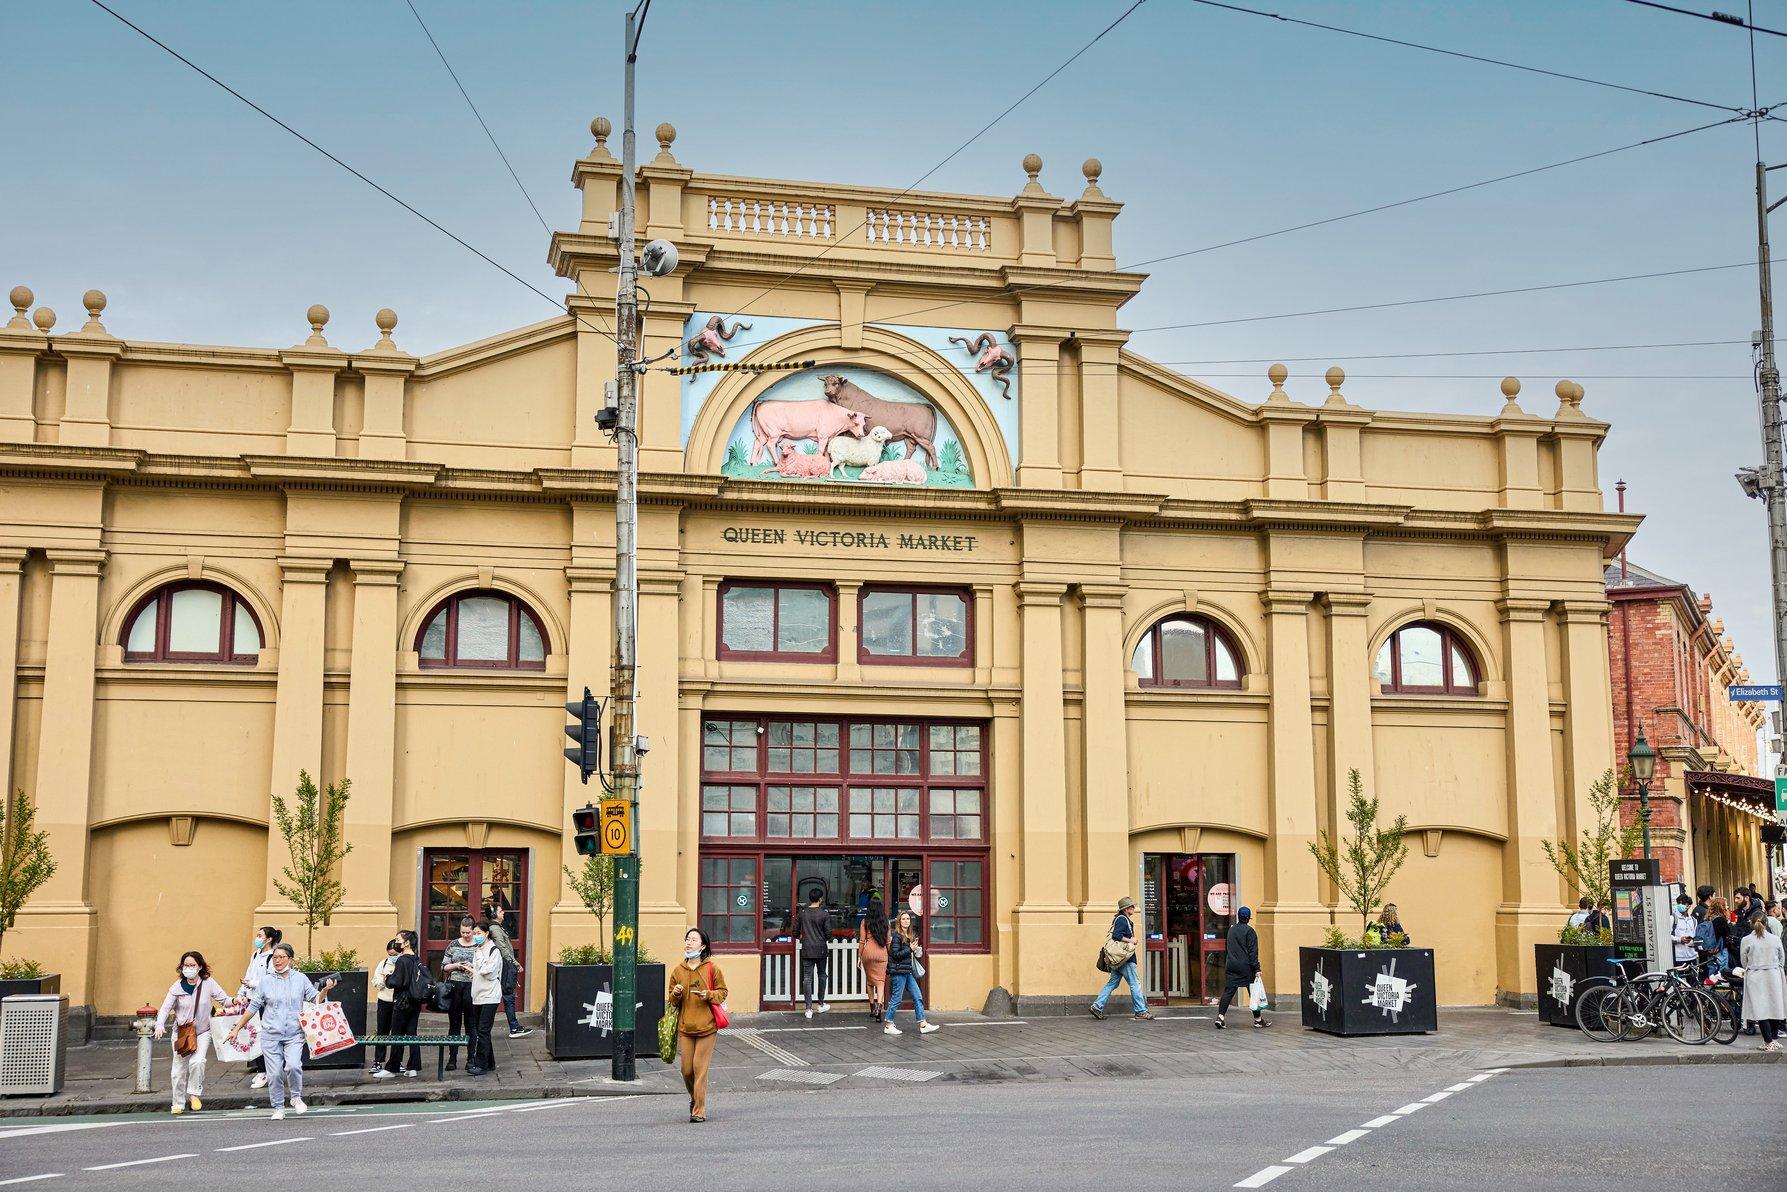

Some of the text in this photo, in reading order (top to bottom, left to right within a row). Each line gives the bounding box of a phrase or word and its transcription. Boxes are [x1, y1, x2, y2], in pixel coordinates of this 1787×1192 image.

[723, 527, 975, 551] QUEEN VICTORIA MARKET
[1736, 688, 1779, 696] Elizabeth St
[610, 828, 620, 841] 10
[1645, 895, 1655, 963] ELIZABETH ST
[616, 925, 634, 946] 49
[1376, 983, 1393, 991] QUEEN
[1376, 991, 1400, 1000] VICTORIA
[1377, 999, 1398, 1008] MARKET
[596, 1010, 613, 1020] VICTO
[596, 1019, 613, 1028] MARK
